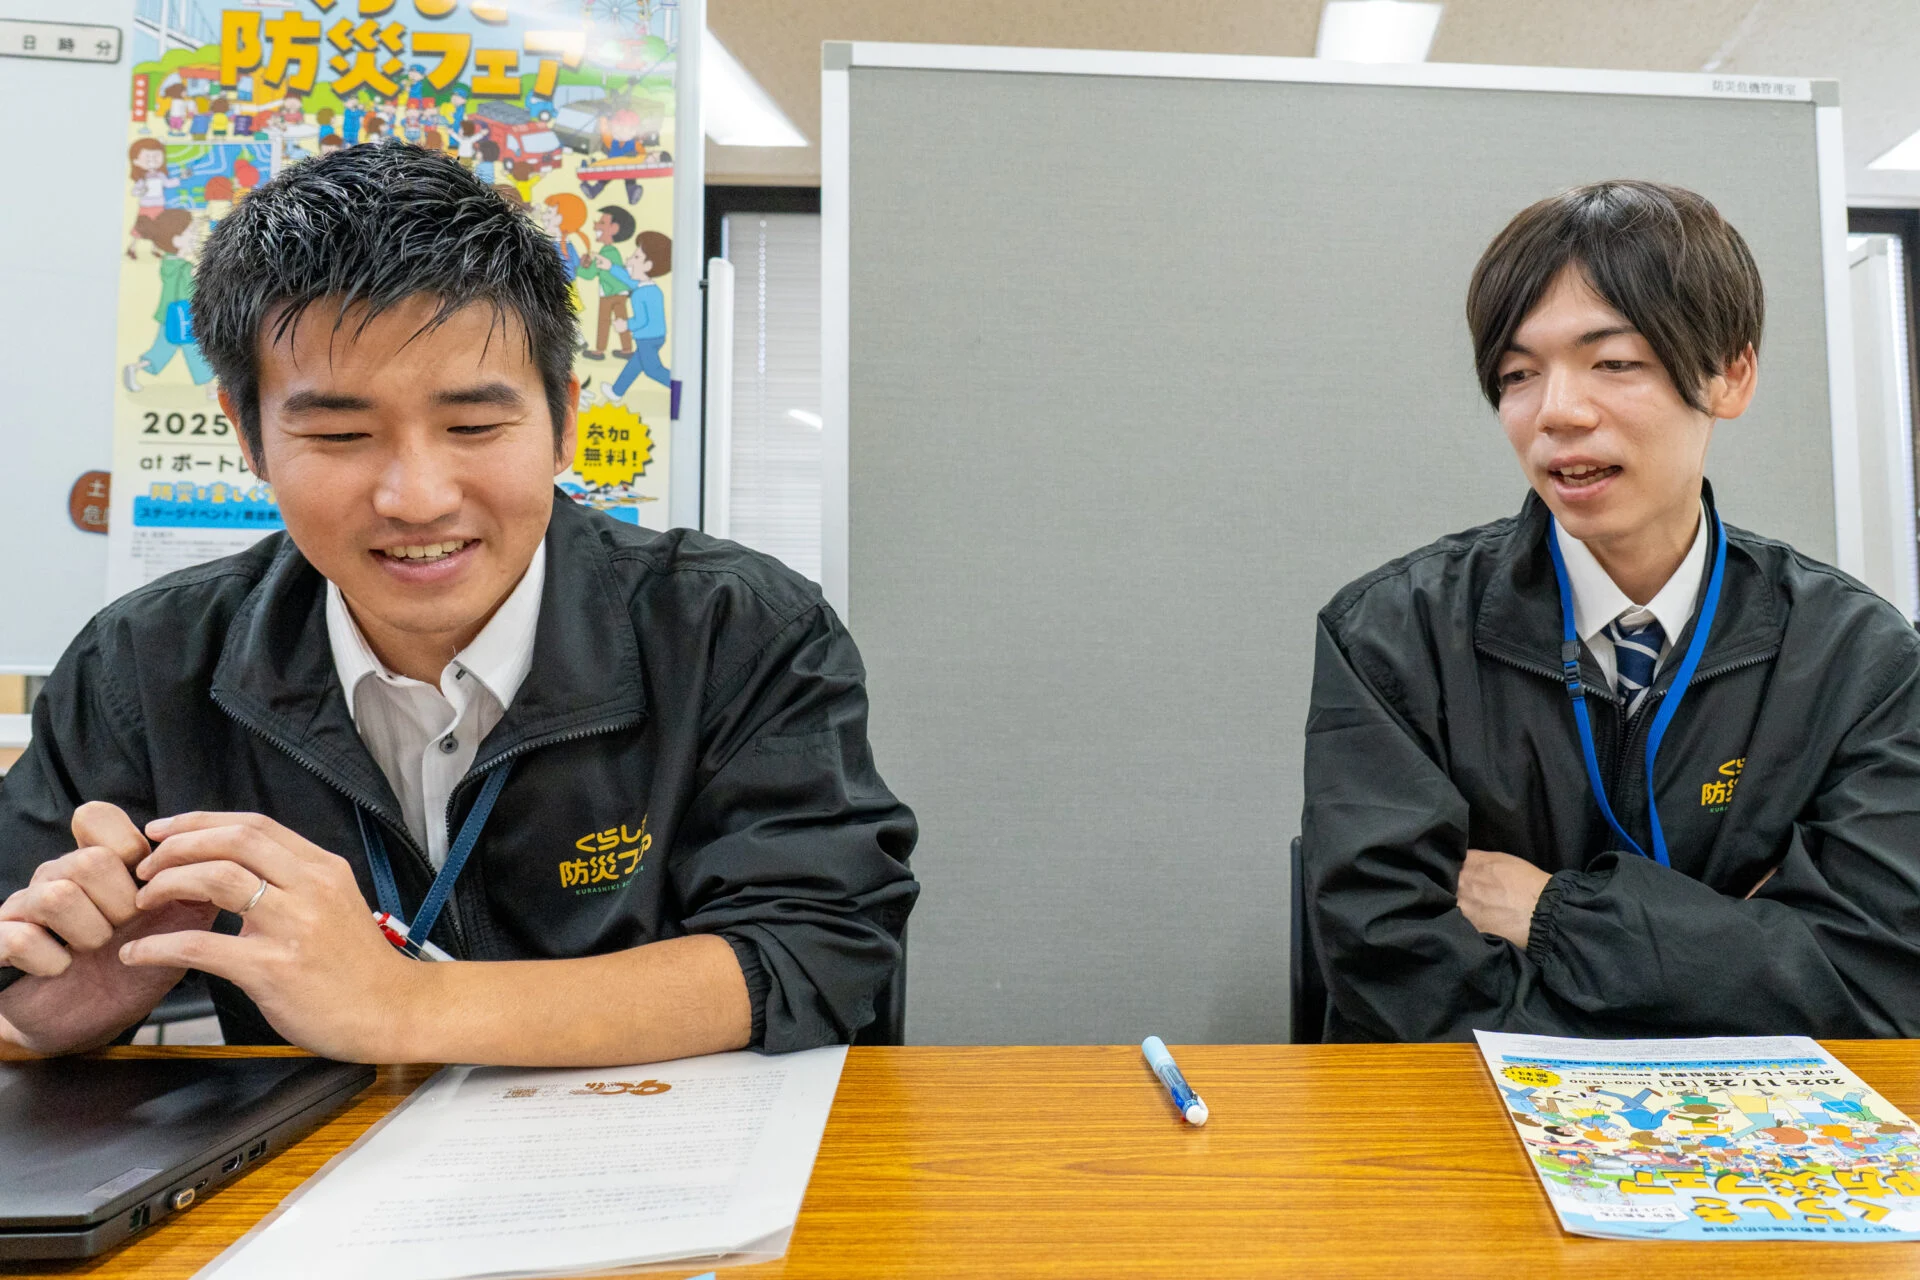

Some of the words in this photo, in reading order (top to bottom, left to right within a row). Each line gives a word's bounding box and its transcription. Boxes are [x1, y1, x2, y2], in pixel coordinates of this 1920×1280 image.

[221, 10, 587, 99] 防災フェア
[1712, 80, 1797, 96] 防災危機管理室
[143, 412, 229, 436] 2025
[587, 423, 630, 445] 参加
[139, 456, 162, 470] at
[584, 447, 638, 467] 無料!
[83, 504, 110, 525] 危
[1786, 1078, 1845, 1086] 2025
[1616, 1170, 1920, 1197] 防災フェア
[1690, 1196, 1893, 1225] くらしき
